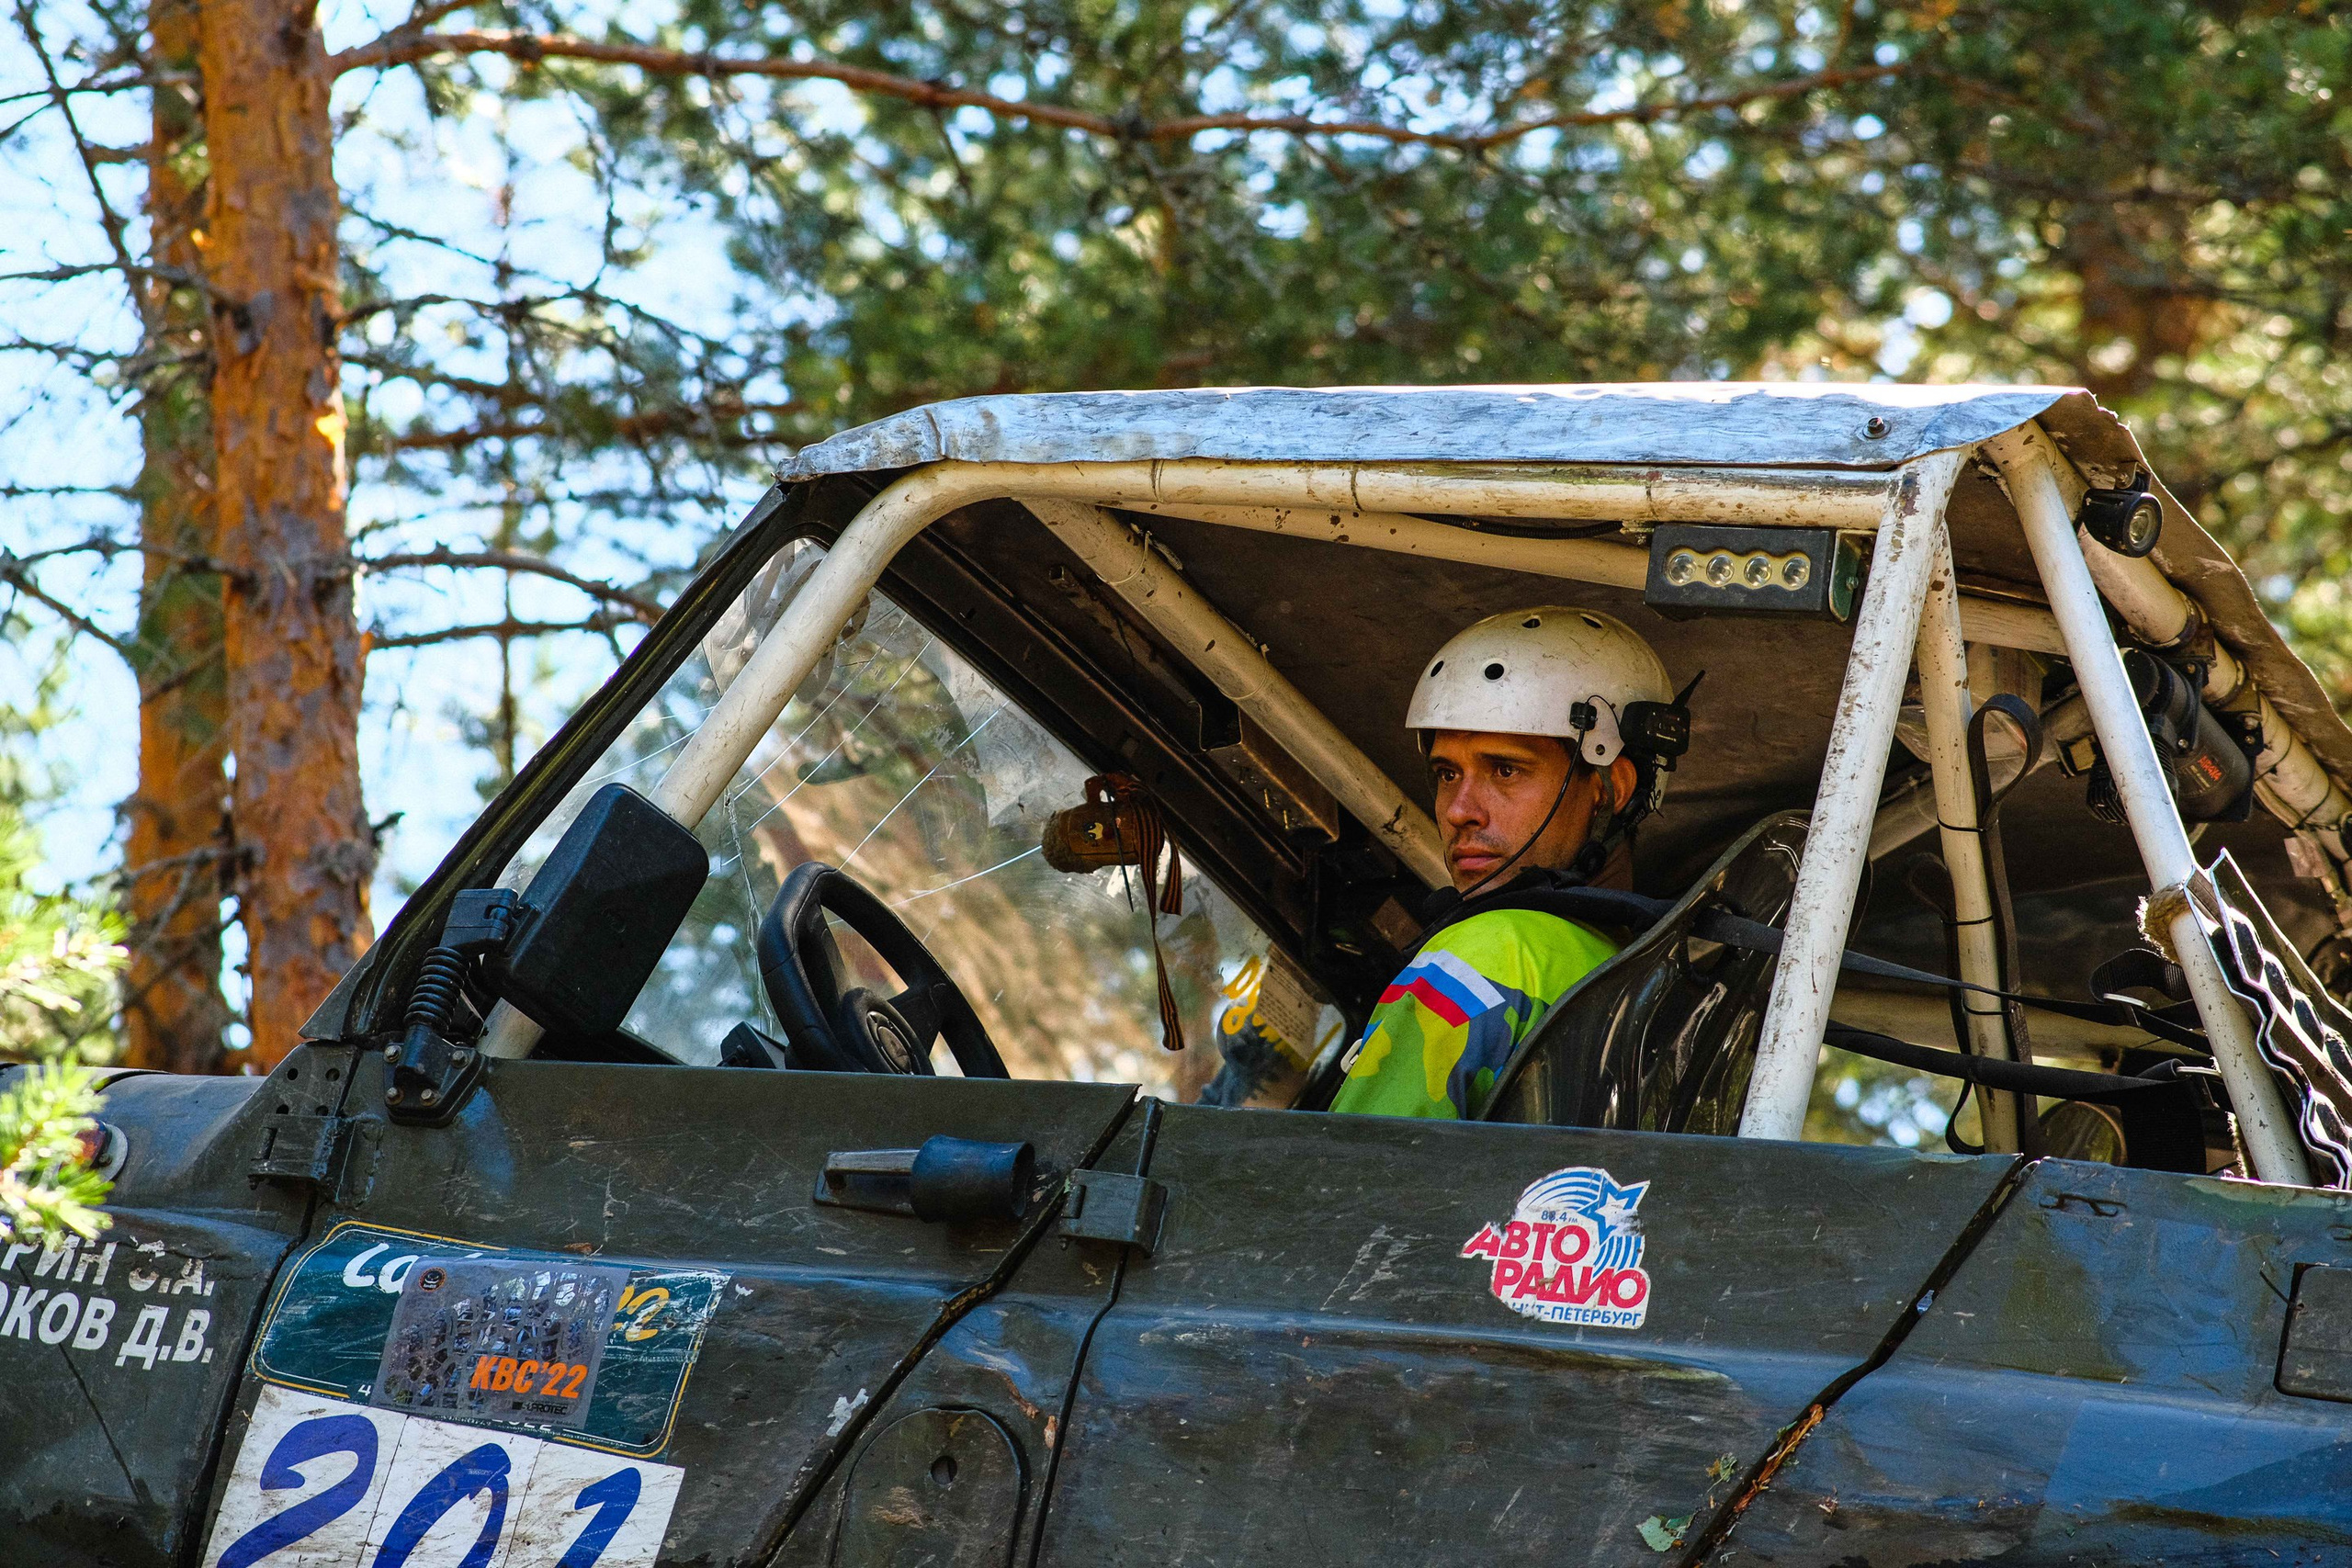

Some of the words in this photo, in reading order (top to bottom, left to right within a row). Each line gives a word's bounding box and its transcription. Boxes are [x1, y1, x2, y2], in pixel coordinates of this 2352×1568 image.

[1462, 1220, 1590, 1265] АВТО
[1492, 1258, 1647, 1309] РАДИО
[0, 1280, 116, 1351] КОВ
[115, 1303, 214, 1371] Д.В.
[1505, 1301, 1642, 1325] НТ-ПЕТЕРБУРГ
[217, 1414, 642, 1568] 201
